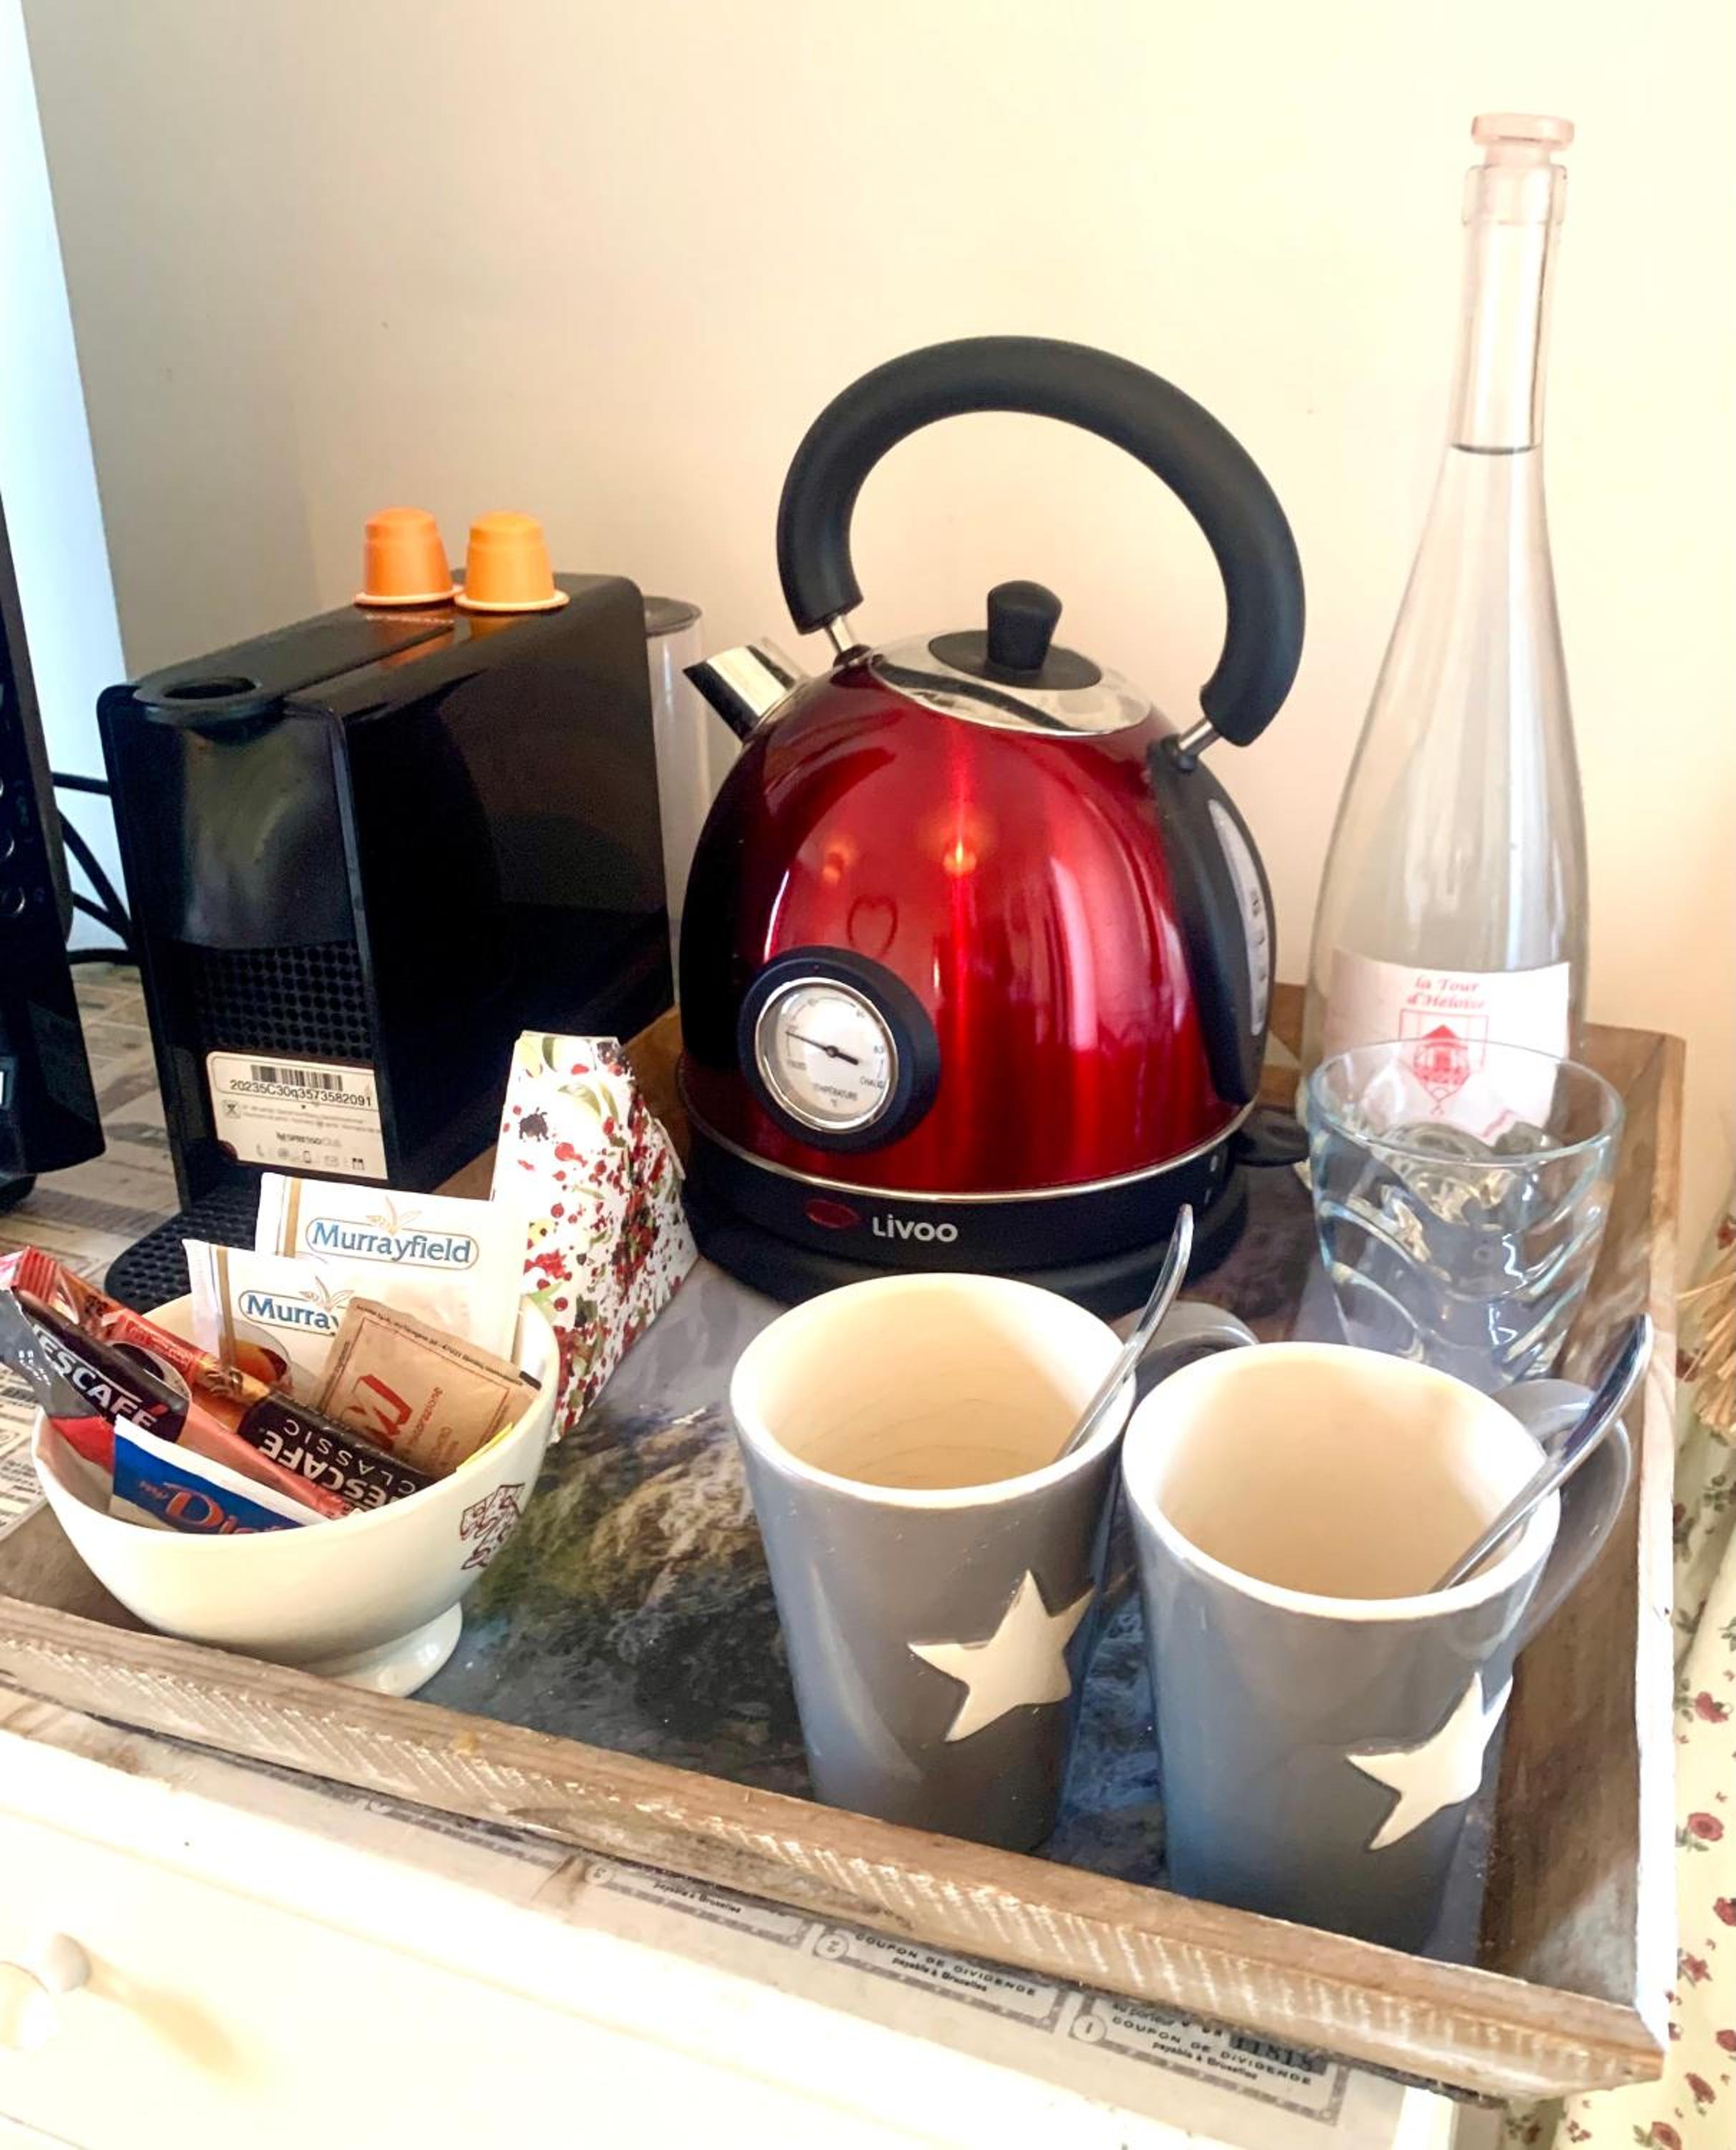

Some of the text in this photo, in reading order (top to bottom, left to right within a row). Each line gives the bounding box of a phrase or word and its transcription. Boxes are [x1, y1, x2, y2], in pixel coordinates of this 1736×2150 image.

[313, 1222, 471, 1263] Murrayfield
[284, 1418, 416, 1496] CLASSIC
[925, 1955, 946, 1969] DE
[953, 1964, 1036, 1997] DIVIDENDE
[1112, 2017, 1181, 2045] COUPON
[1190, 2041, 1212, 2053] DE
[1220, 2050, 1312, 2086] DIVIDENDE
